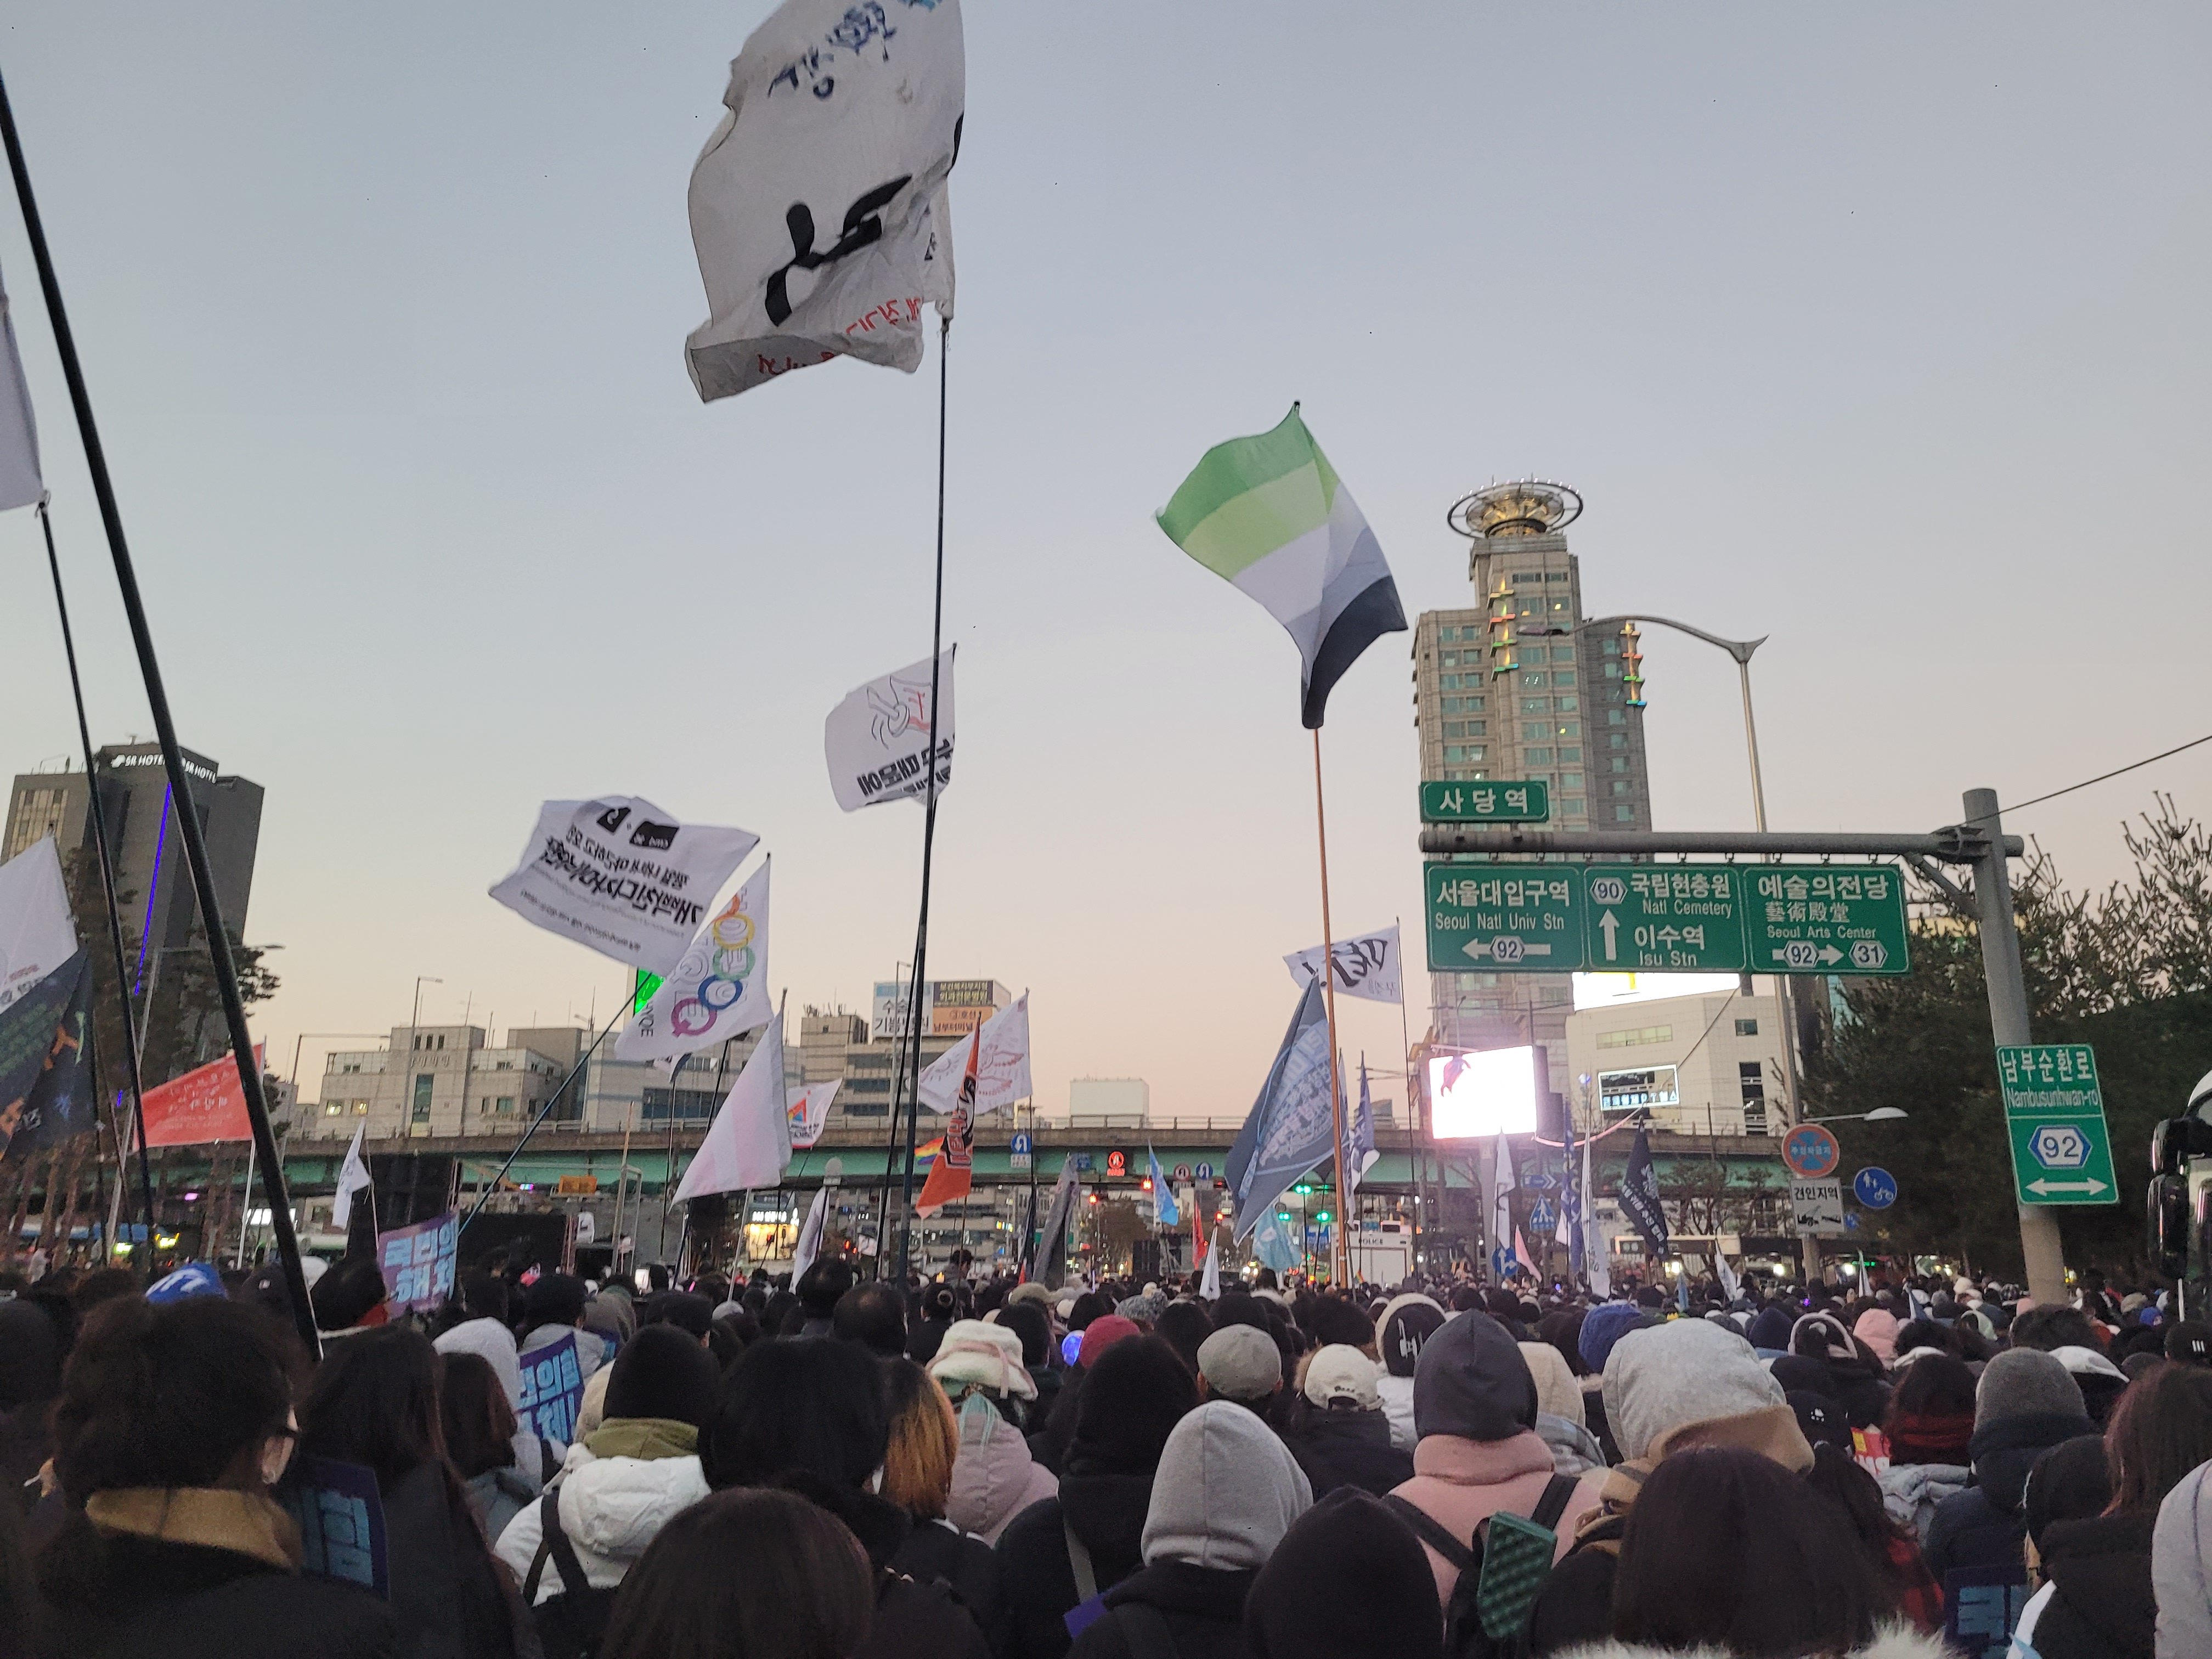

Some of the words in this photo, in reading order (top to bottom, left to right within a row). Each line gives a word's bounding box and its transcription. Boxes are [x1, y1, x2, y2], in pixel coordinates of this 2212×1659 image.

[125, 755, 137, 766] SR
[138, 754, 166, 766] HOTE
[1440, 788, 1529, 815] 사당역
[1437, 879, 1571, 907] 서울대입구역
[1598, 882, 1621, 901] 90
[1630, 873, 1731, 899] 국립현충원
[1758, 875, 1888, 900] 예술의전당
[1643, 899, 1667, 915] Natl
[1674, 900, 1732, 919] Cemetery
[1435, 912, 1470, 930] Seoul
[1478, 912, 1503, 930] Natl
[1509, 914, 1536, 930] Univ
[1544, 915, 1565, 930] Stn
[1635, 924, 1705, 950] 이수역
[1767, 925, 1801, 939] Seoul
[1807, 926, 1831, 939] Arts
[1837, 926, 1876, 939] Center
[1496, 940, 1519, 959] 92
[1639, 951, 1663, 966] Isu
[1671, 951, 1697, 966] Stn
[1790, 944, 1813, 963] 92
[1857, 944, 1880, 963] 31
[2001, 1049, 2093, 1084] 남부순환로
[2007, 1086, 2098, 1108] Nambusunhwan-ro
[2043, 1136, 2079, 1158] 92
[1794, 1186, 1838, 1200] 견인지역
